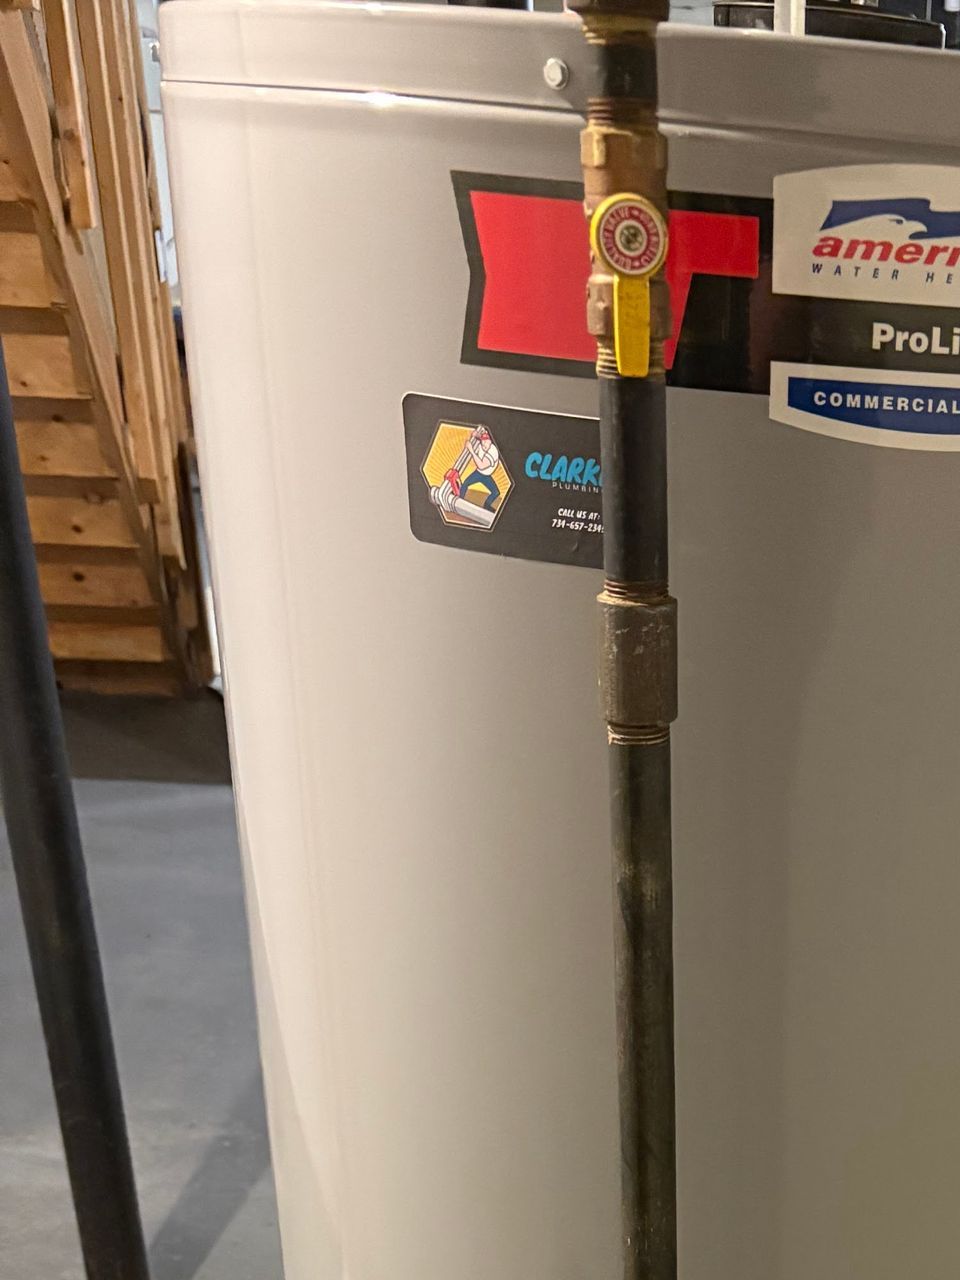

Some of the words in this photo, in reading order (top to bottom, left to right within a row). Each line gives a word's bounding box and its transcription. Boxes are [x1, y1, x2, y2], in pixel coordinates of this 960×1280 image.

[812, 263, 900, 281] WATER
[525, 451, 601, 486] CLARK
[552, 481, 602, 494] PLUMBIN
[558, 508, 574, 518] CALL
[576, 511, 587, 519] US
